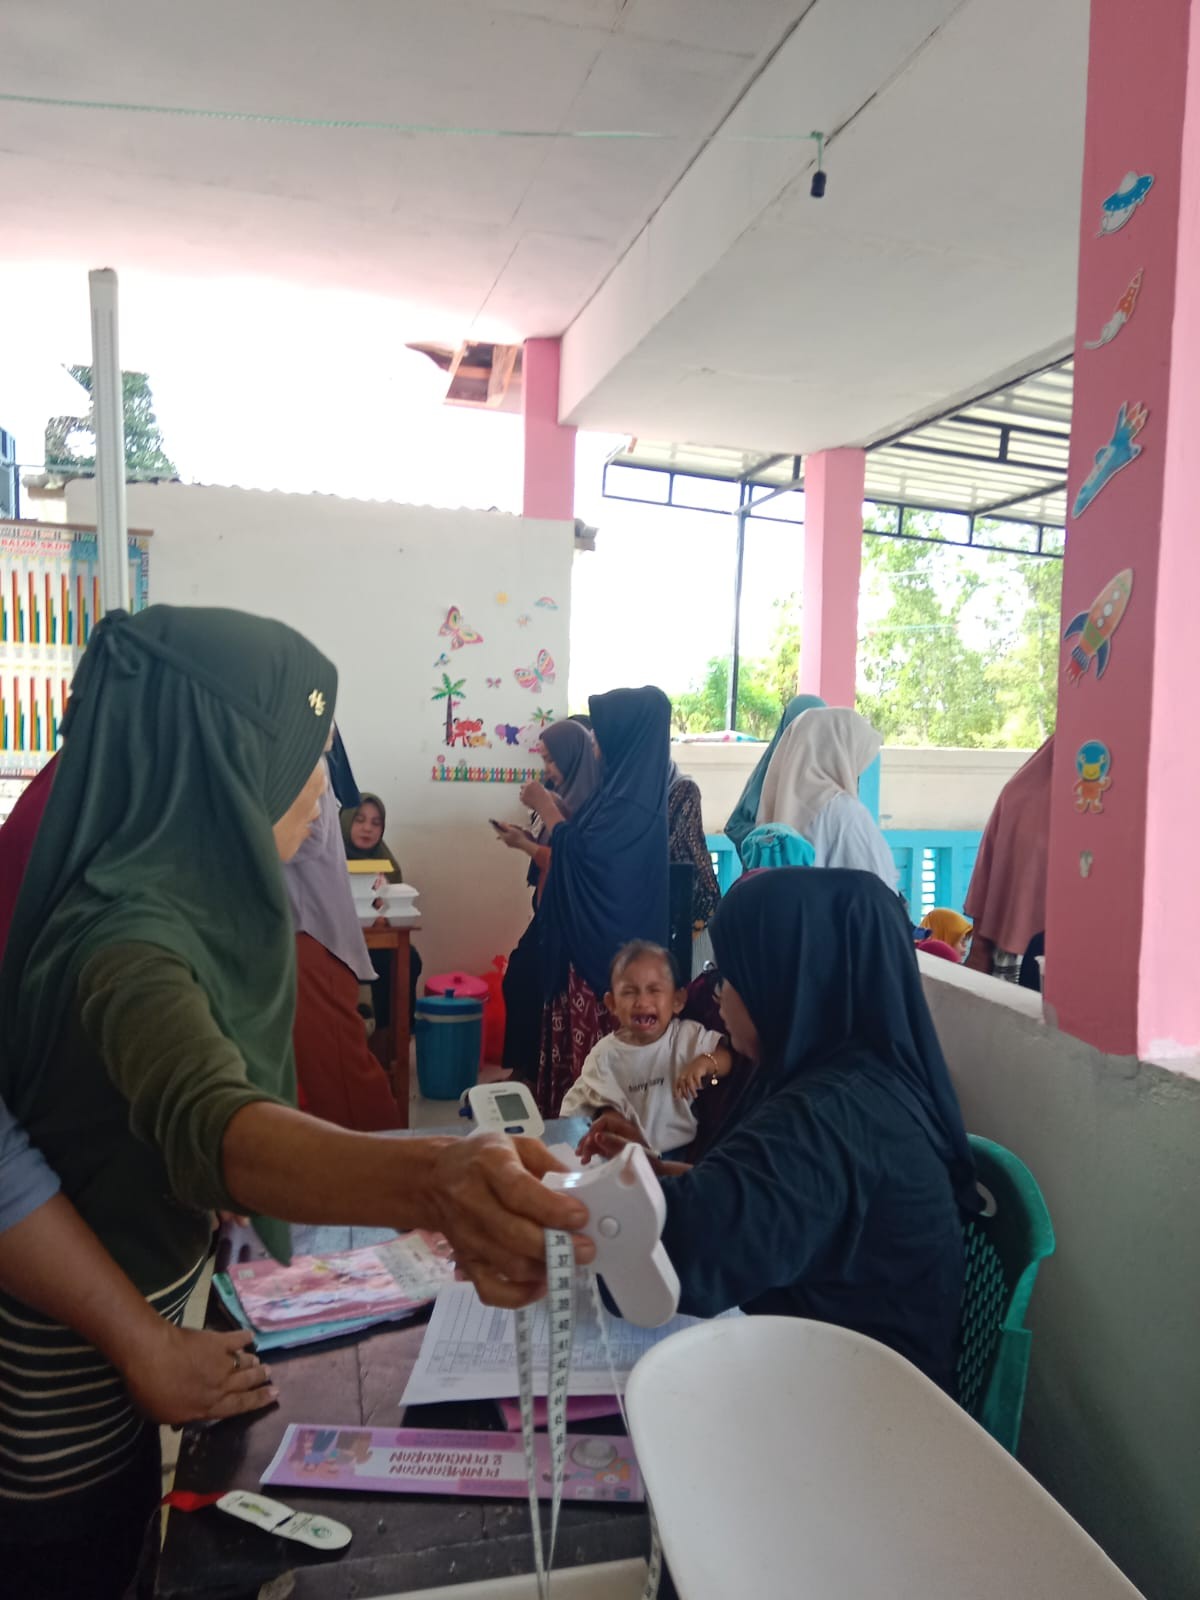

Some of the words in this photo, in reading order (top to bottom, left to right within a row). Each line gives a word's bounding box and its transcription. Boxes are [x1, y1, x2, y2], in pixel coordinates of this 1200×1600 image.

[555, 1234, 567, 1246] 36
[558, 1254, 569, 1267] 37
[559, 1277, 569, 1289] 38
[559, 1298, 569, 1310] 39
[559, 1319, 569, 1331] 40
[559, 1338, 569, 1350] 41
[557, 1358, 567, 1369] 42
